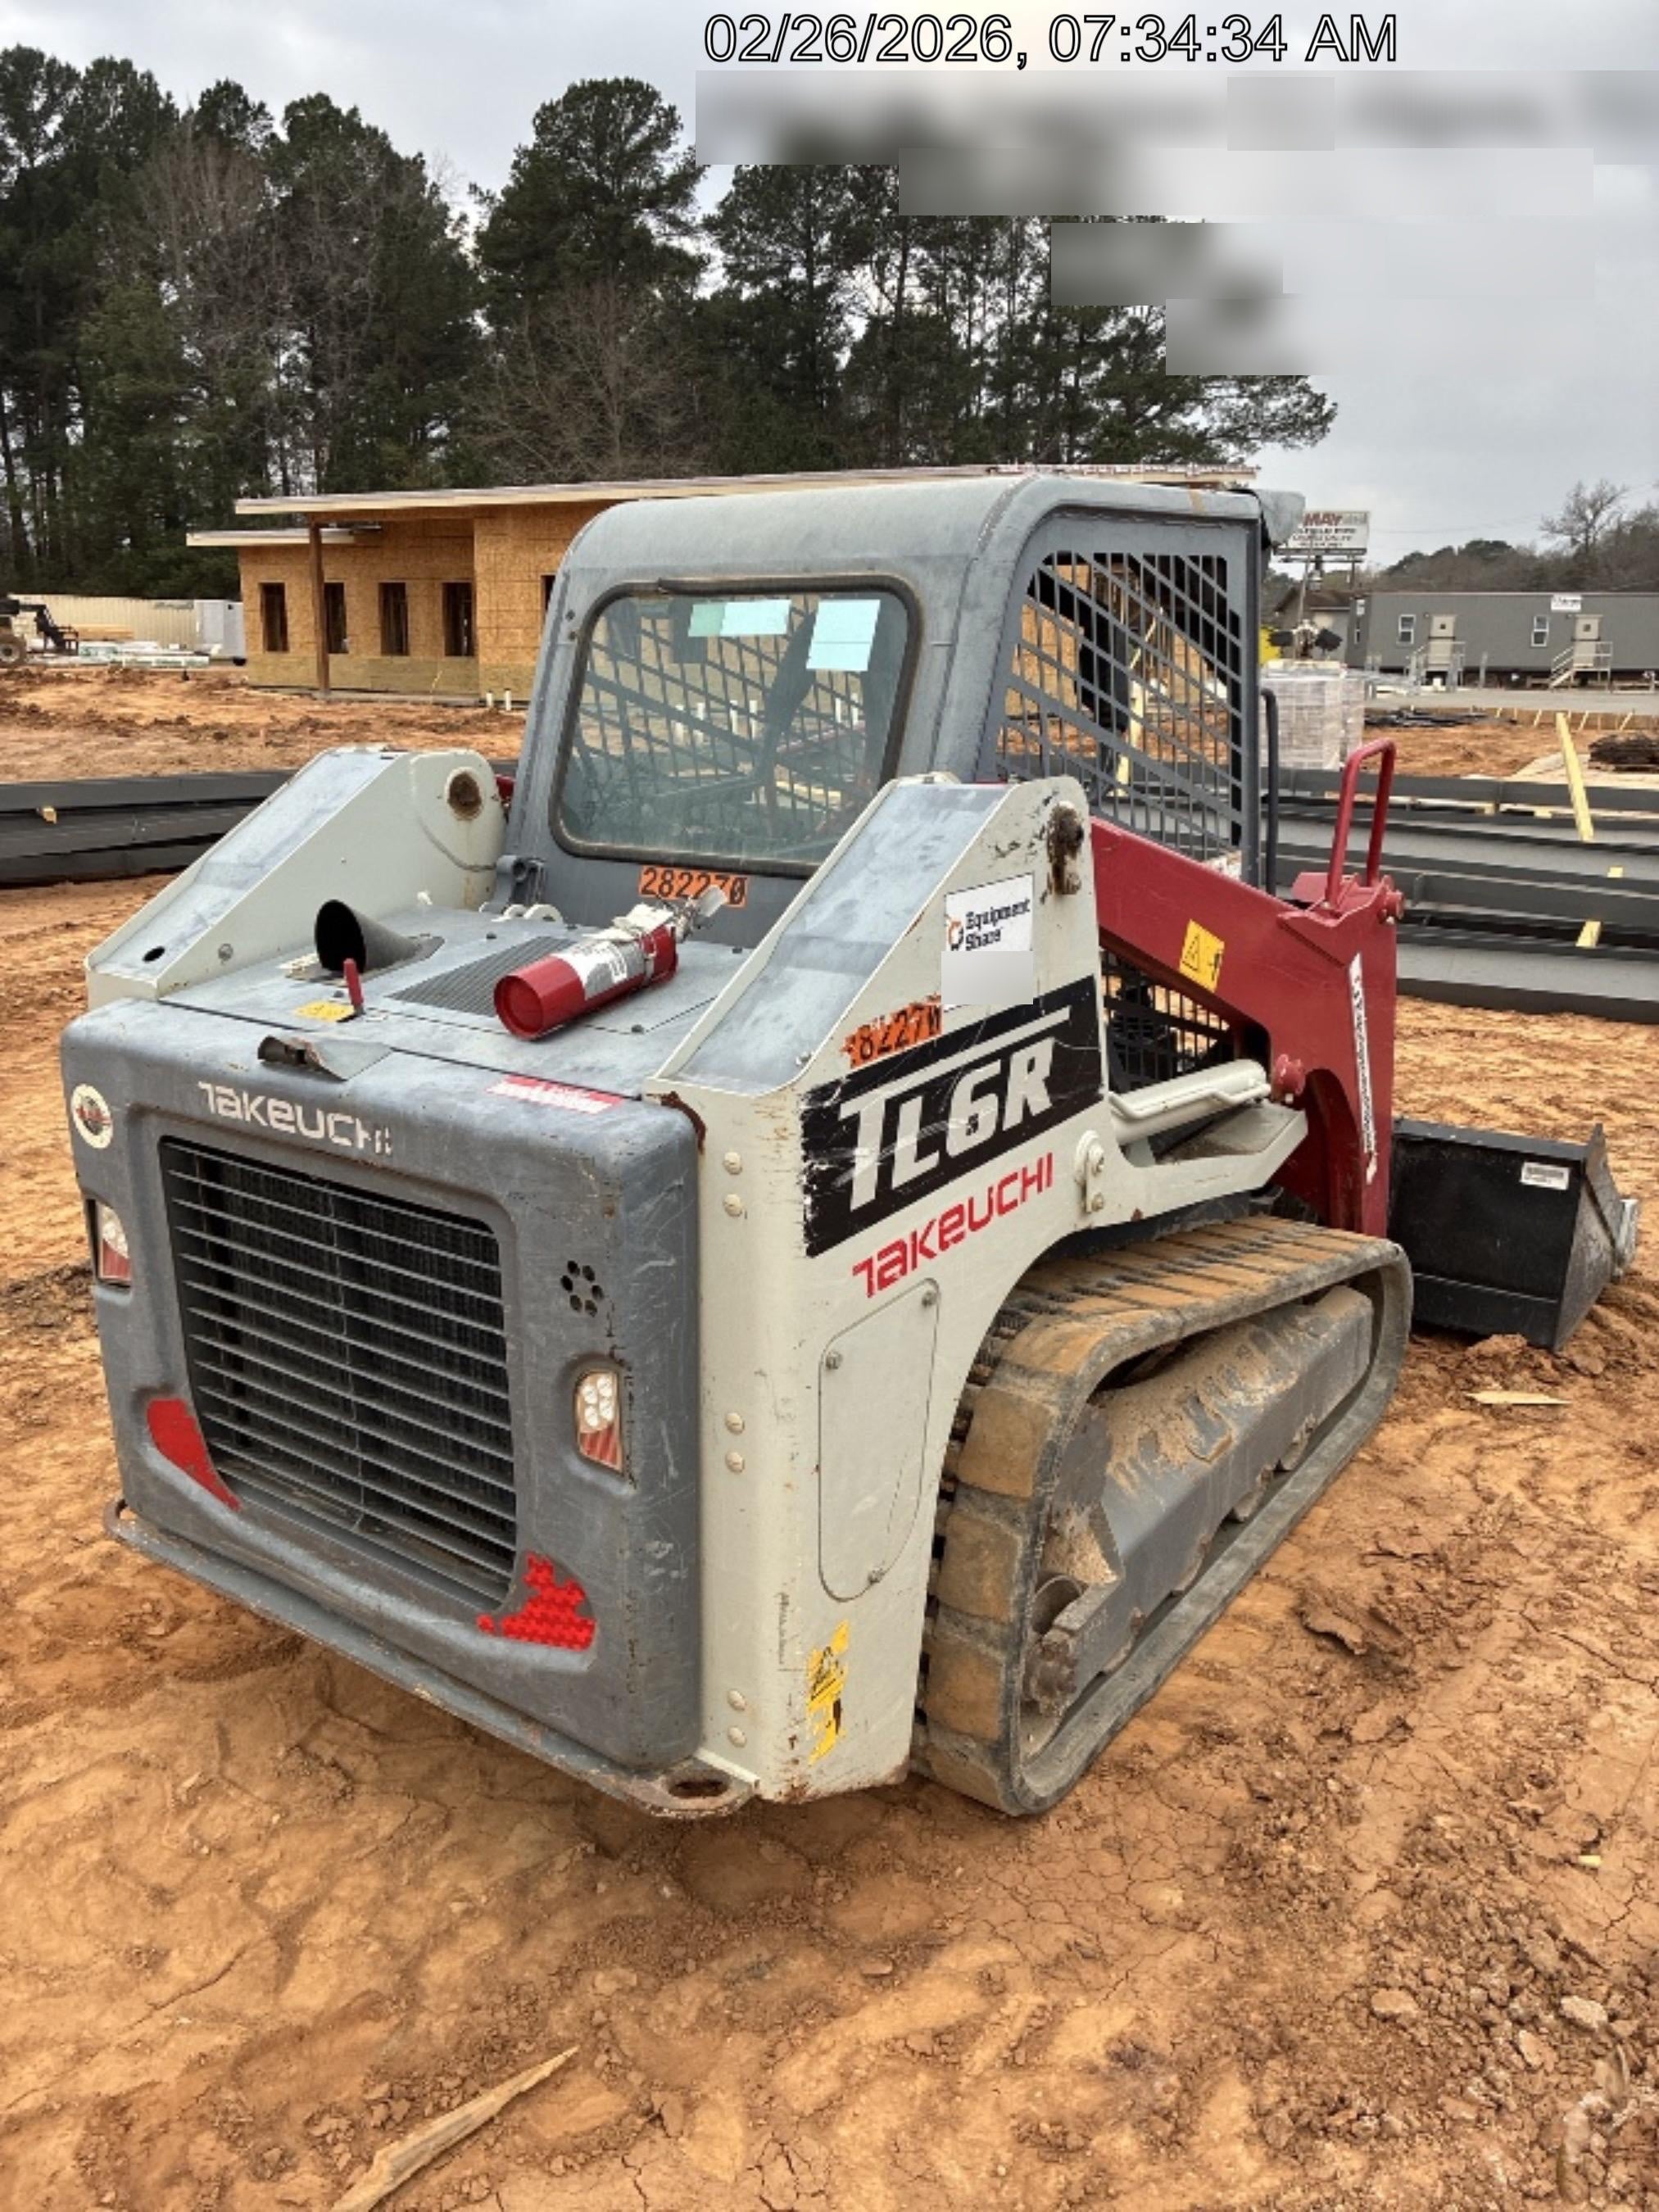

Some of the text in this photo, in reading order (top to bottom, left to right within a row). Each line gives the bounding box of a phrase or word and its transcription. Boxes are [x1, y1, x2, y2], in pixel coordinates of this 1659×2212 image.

[965, 899, 1031, 931] Equipment
[965, 929, 1001, 951] Share
[838, 1036, 1057, 1213] TL6R
